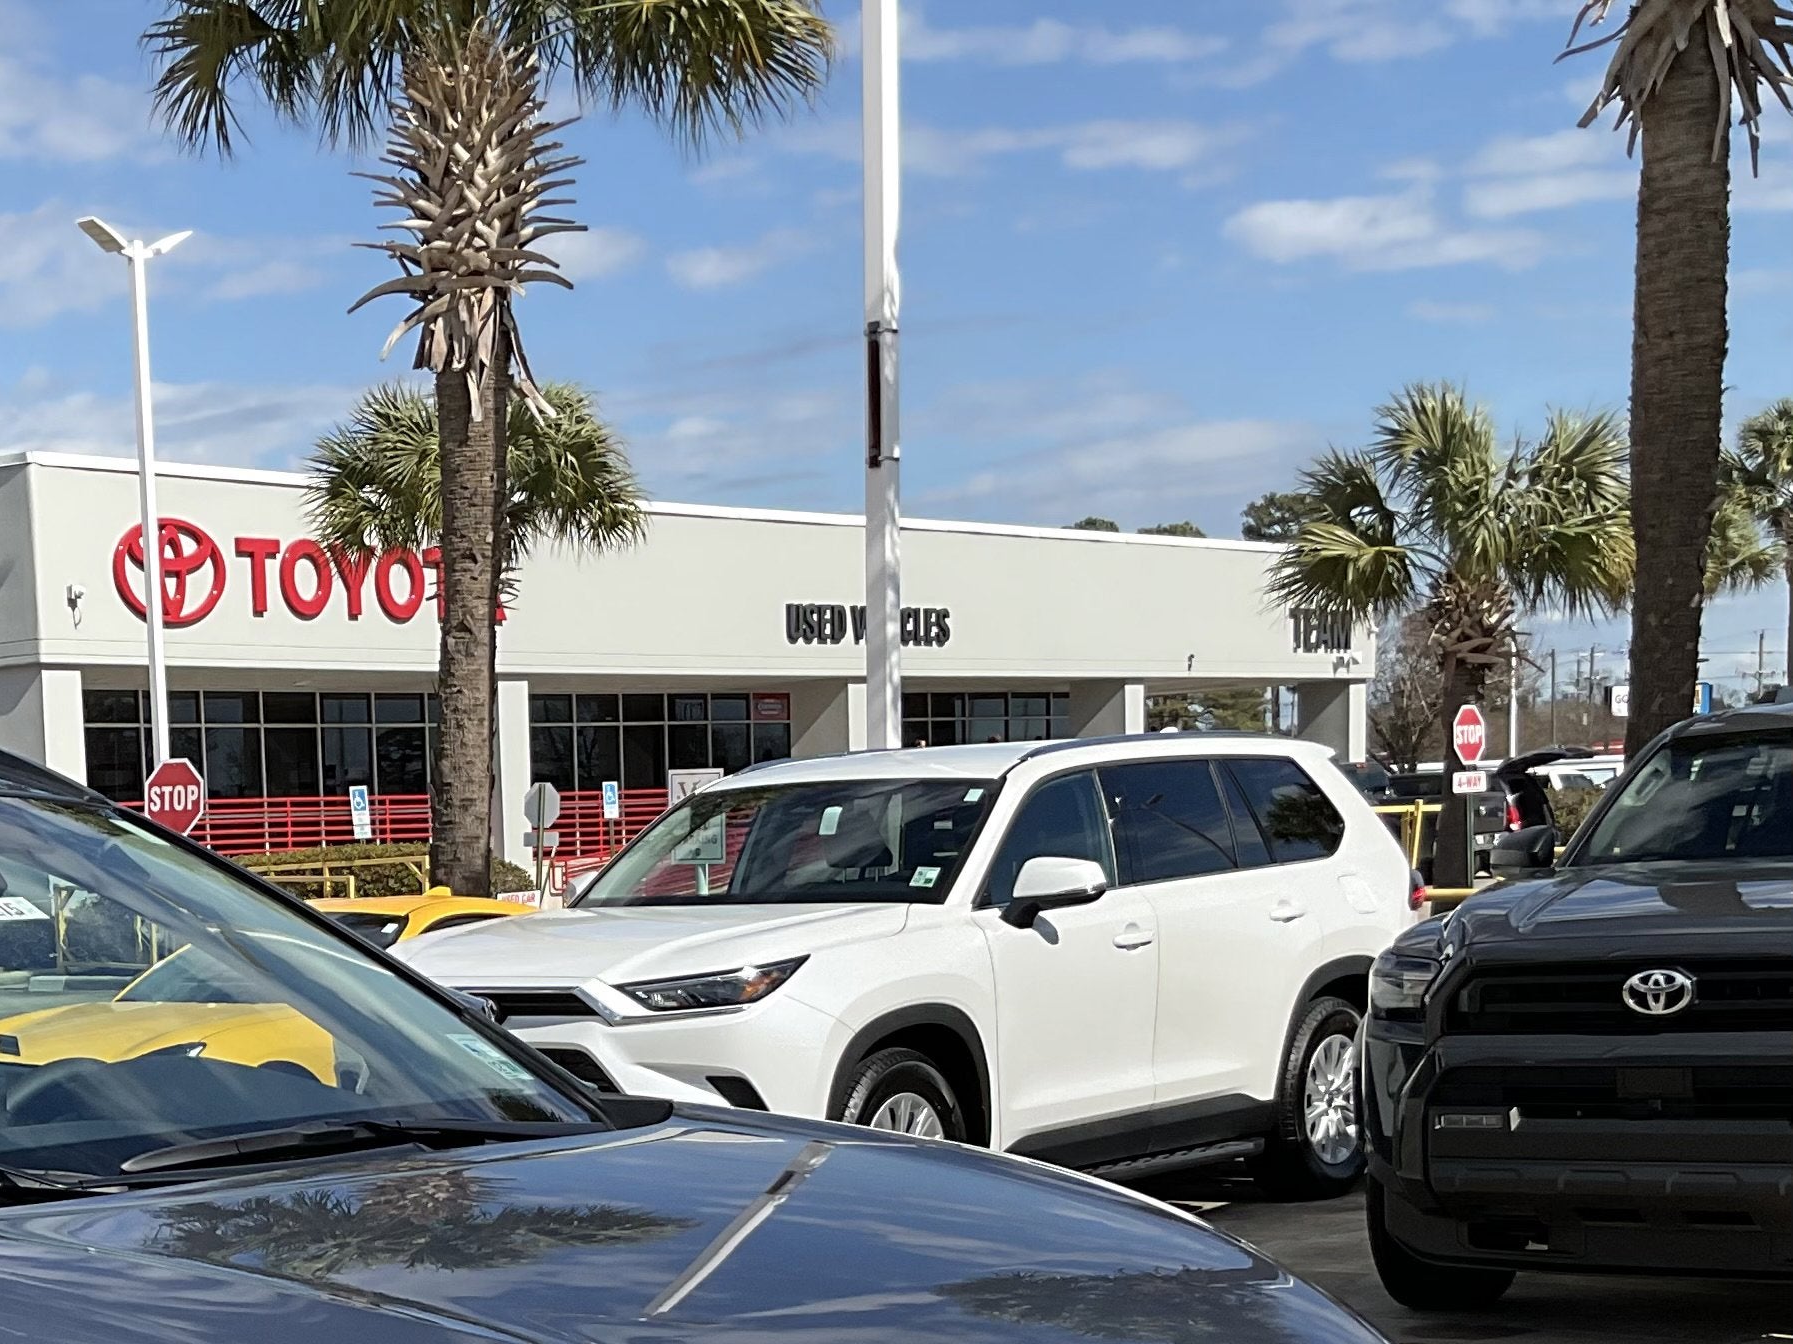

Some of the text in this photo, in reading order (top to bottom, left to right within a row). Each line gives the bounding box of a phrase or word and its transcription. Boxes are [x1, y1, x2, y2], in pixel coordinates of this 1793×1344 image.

[235, 537, 507, 625] TOYO
[785, 603, 847, 645] USED
[1289, 608, 1352, 653] TEAM
[1456, 724, 1483, 745] STOP
[149, 784, 199, 813] STOP
[1457, 775, 1482, 789] 4-WAY
